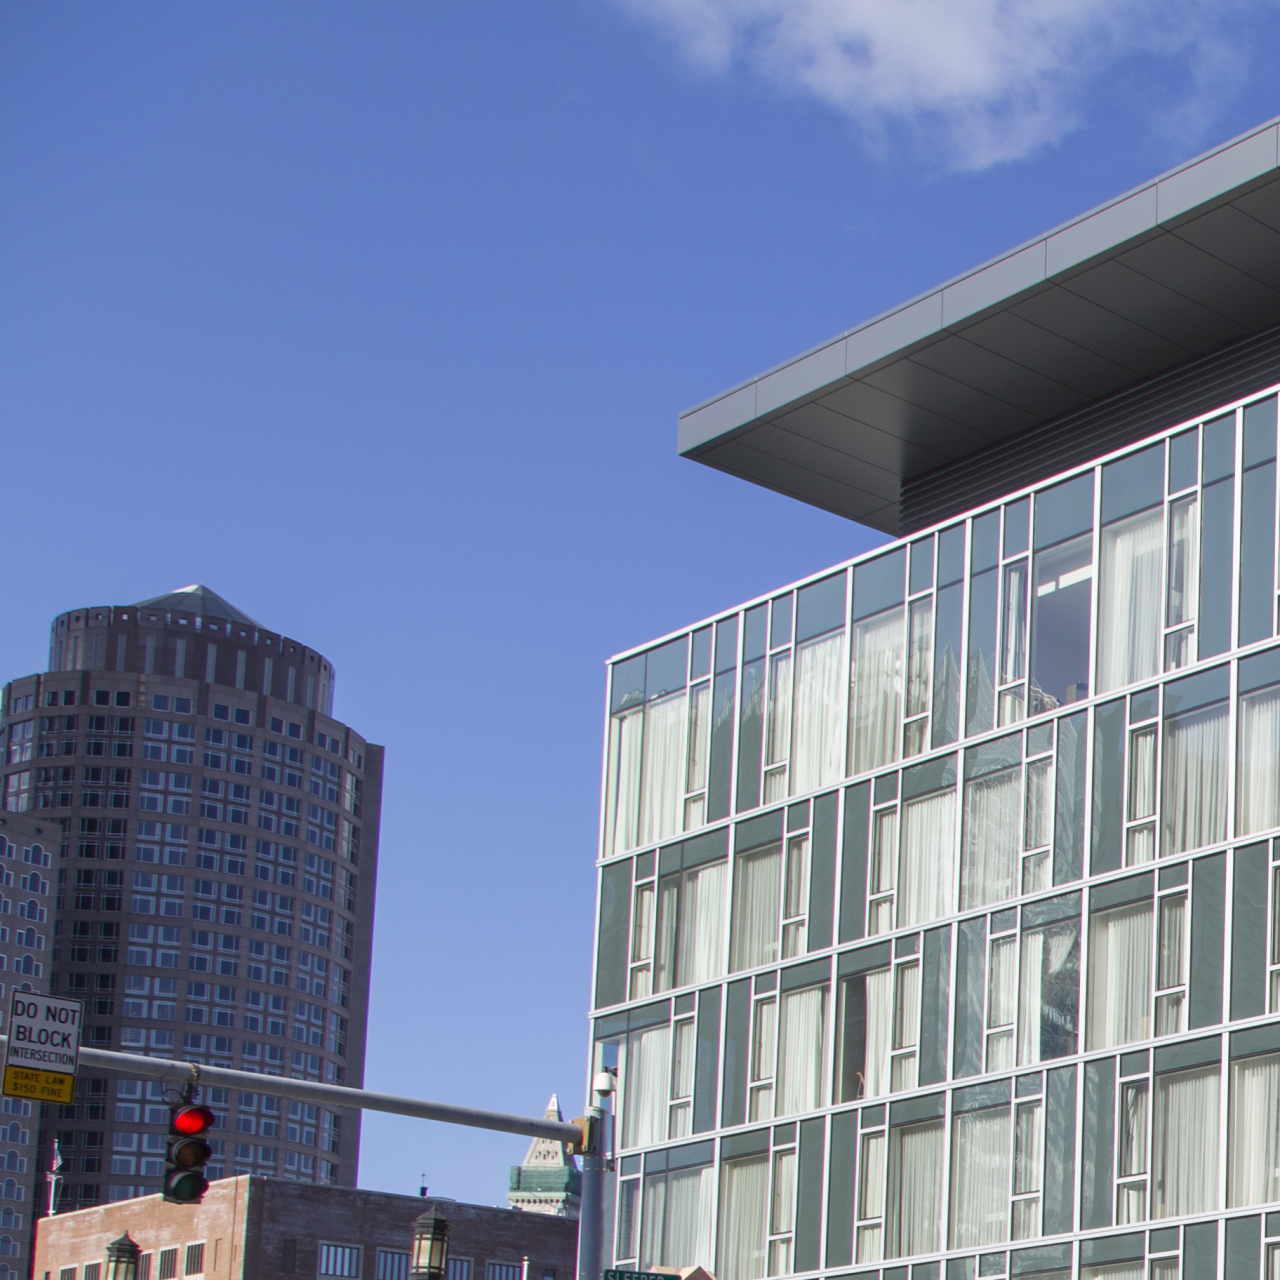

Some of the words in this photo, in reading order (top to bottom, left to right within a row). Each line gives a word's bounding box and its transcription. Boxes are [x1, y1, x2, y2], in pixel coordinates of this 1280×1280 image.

[14, 1000, 38, 1019] DO
[45, 1005, 79, 1026] NOT
[15, 1024, 72, 1049] BLOCK
[10, 1045, 75, 1066] INTERSECTION
[13, 1070, 41, 1083] STATE
[45, 1075, 66, 1086] LAW
[12, 1082, 37, 1094] $150
[41, 1086, 63, 1098] FINE
